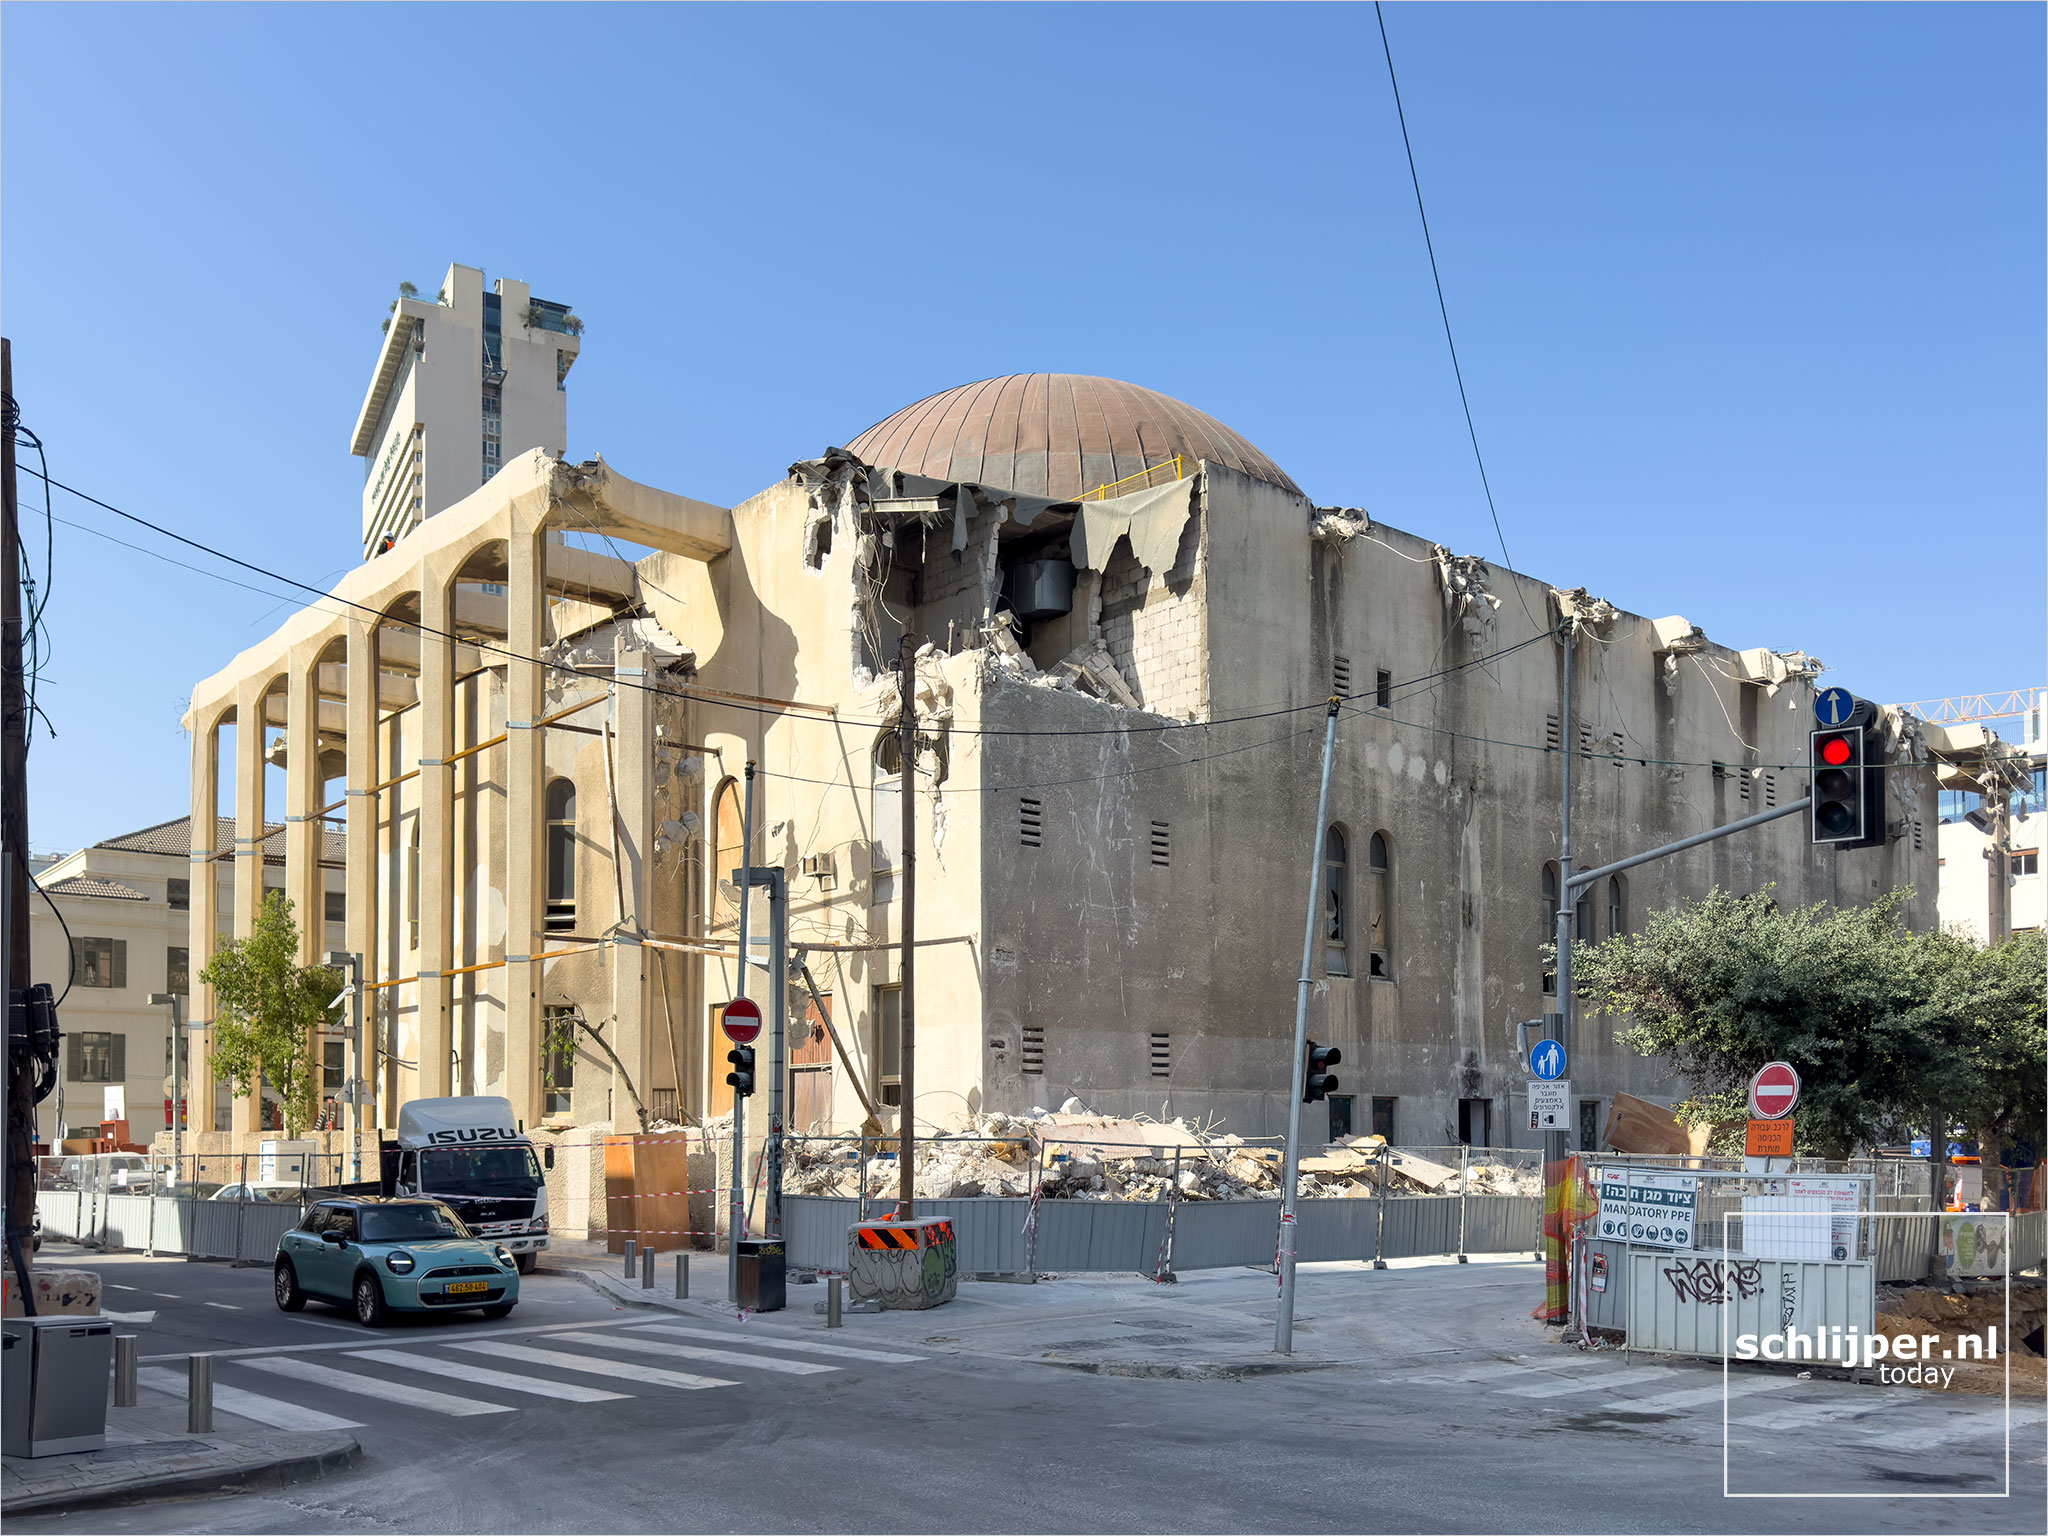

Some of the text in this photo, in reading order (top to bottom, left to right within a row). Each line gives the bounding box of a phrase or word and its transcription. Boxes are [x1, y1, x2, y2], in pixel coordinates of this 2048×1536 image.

[1773, 1122, 1789, 1131] לרכב
[427, 1128, 517, 1144] ISUZU
[1757, 1134, 1781, 1142] הכניסה
[1606, 1185, 1692, 1204] ציוד מגן חבה!
[1603, 1203, 1691, 1221] MANDATORY PPE
